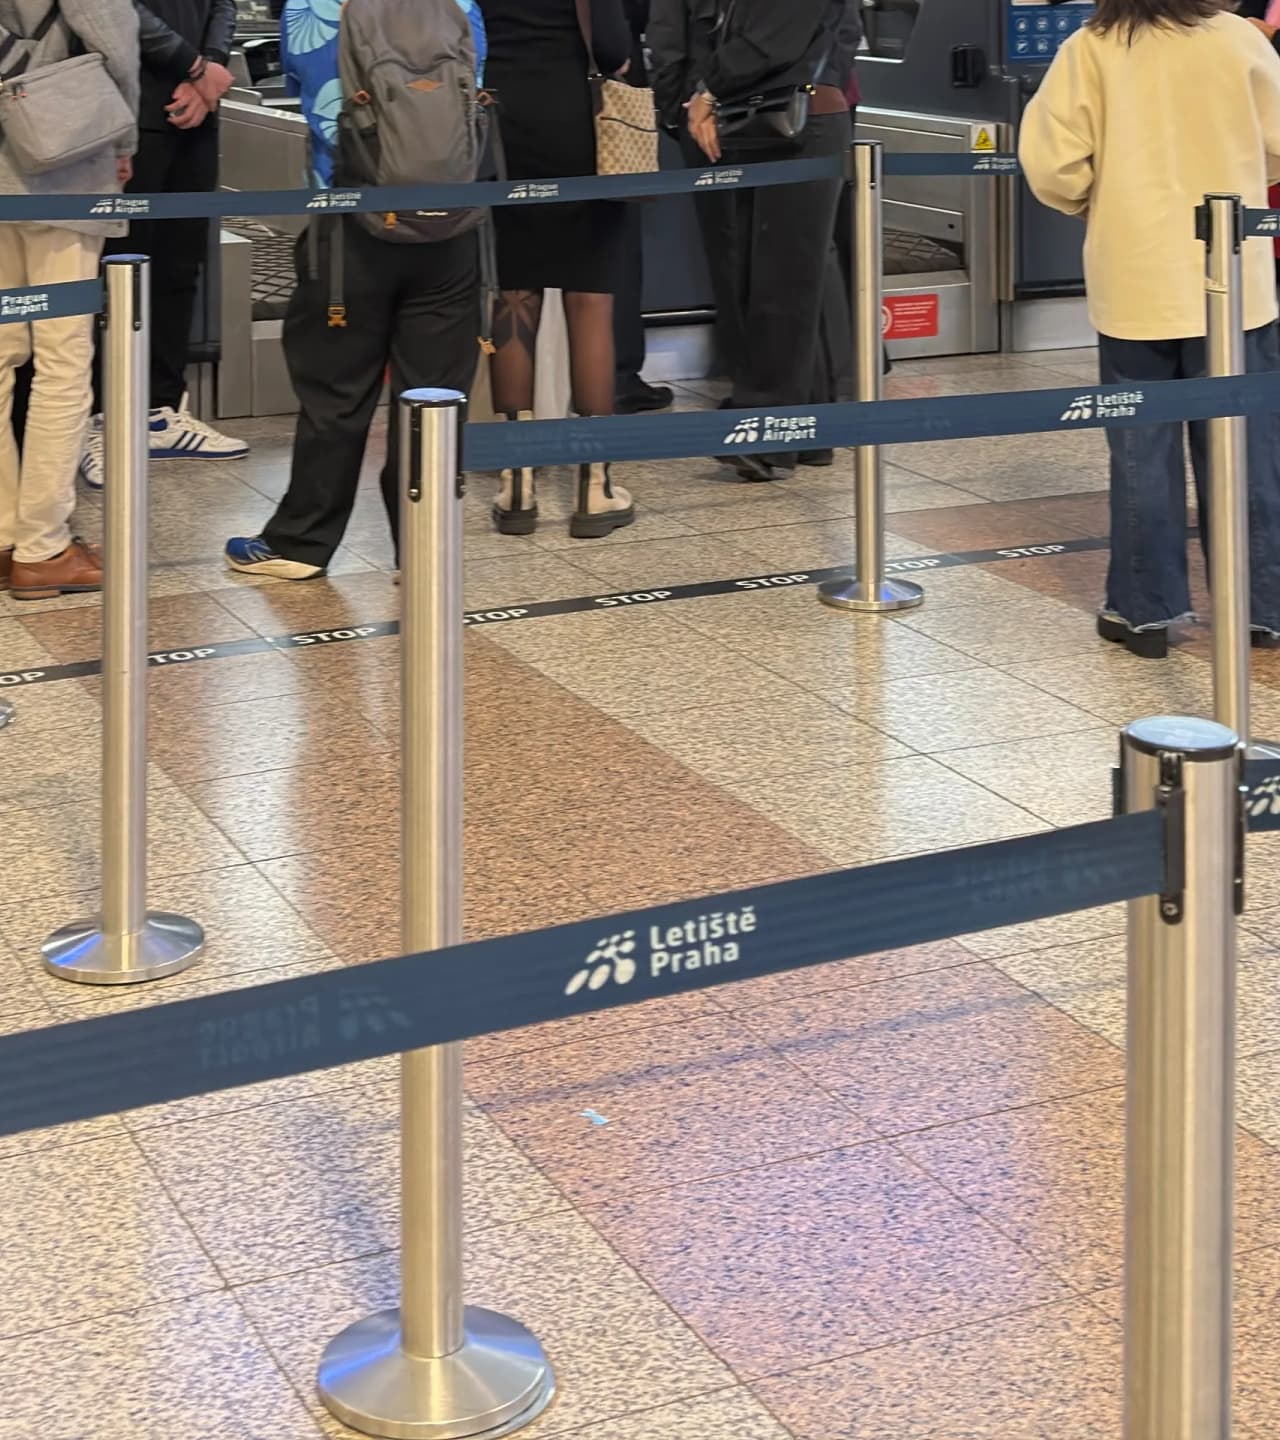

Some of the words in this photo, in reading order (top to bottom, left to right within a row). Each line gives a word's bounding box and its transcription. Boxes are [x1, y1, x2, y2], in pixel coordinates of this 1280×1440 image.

[0, 293, 49, 307] Prague
[0, 302, 49, 317] Airport
[1096, 406, 1137, 419] Praha
[764, 416, 817, 430] Prague
[763, 427, 817, 443] Airport
[997, 544, 1065, 559] STOP
[735, 574, 809, 589] STOP
[595, 591, 672, 607] STOP
[292, 627, 377, 645] STOP
[148, 648, 215, 663] TOP
[650, 905, 757, 951] Letiště
[650, 941, 740, 977] Praha
